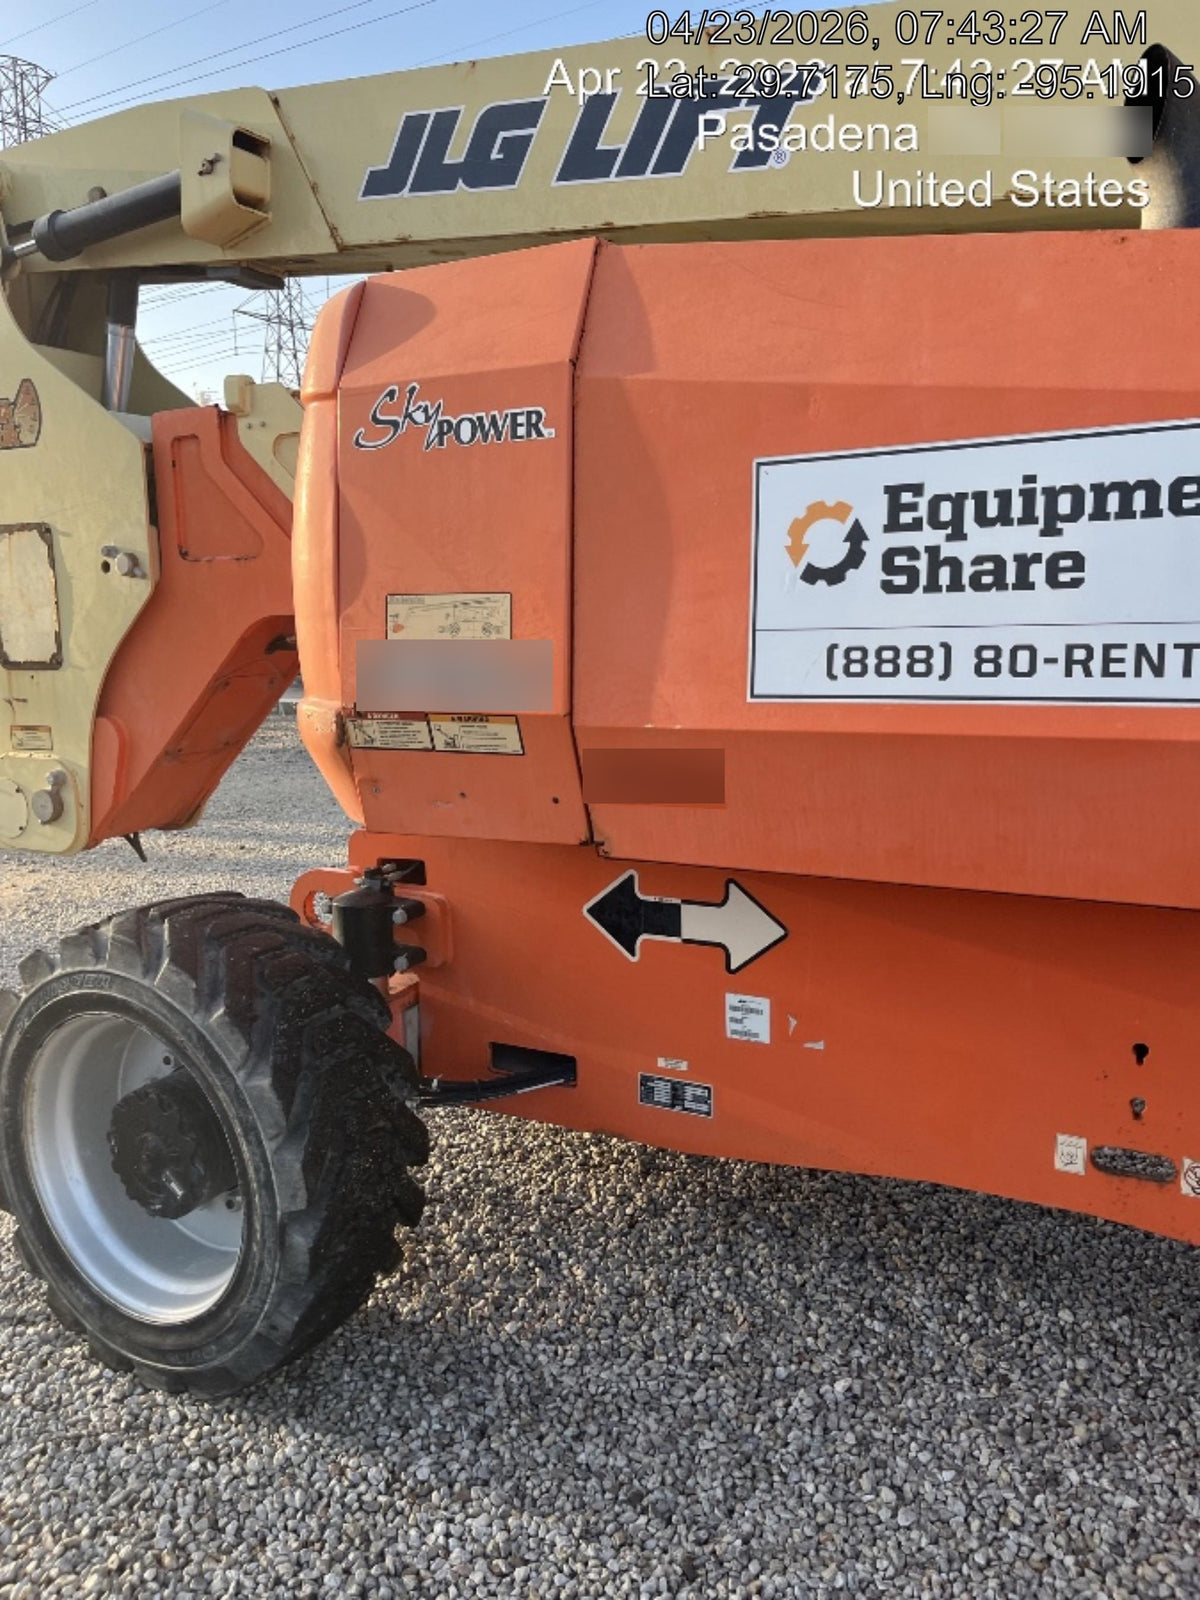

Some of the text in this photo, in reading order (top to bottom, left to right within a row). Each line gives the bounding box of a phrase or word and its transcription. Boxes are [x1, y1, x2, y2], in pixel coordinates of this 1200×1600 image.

[358, 97, 550, 200] JLG
[880, 545, 1086, 594] Share
[826, 641, 1200, 681] (888) 80-RENT
